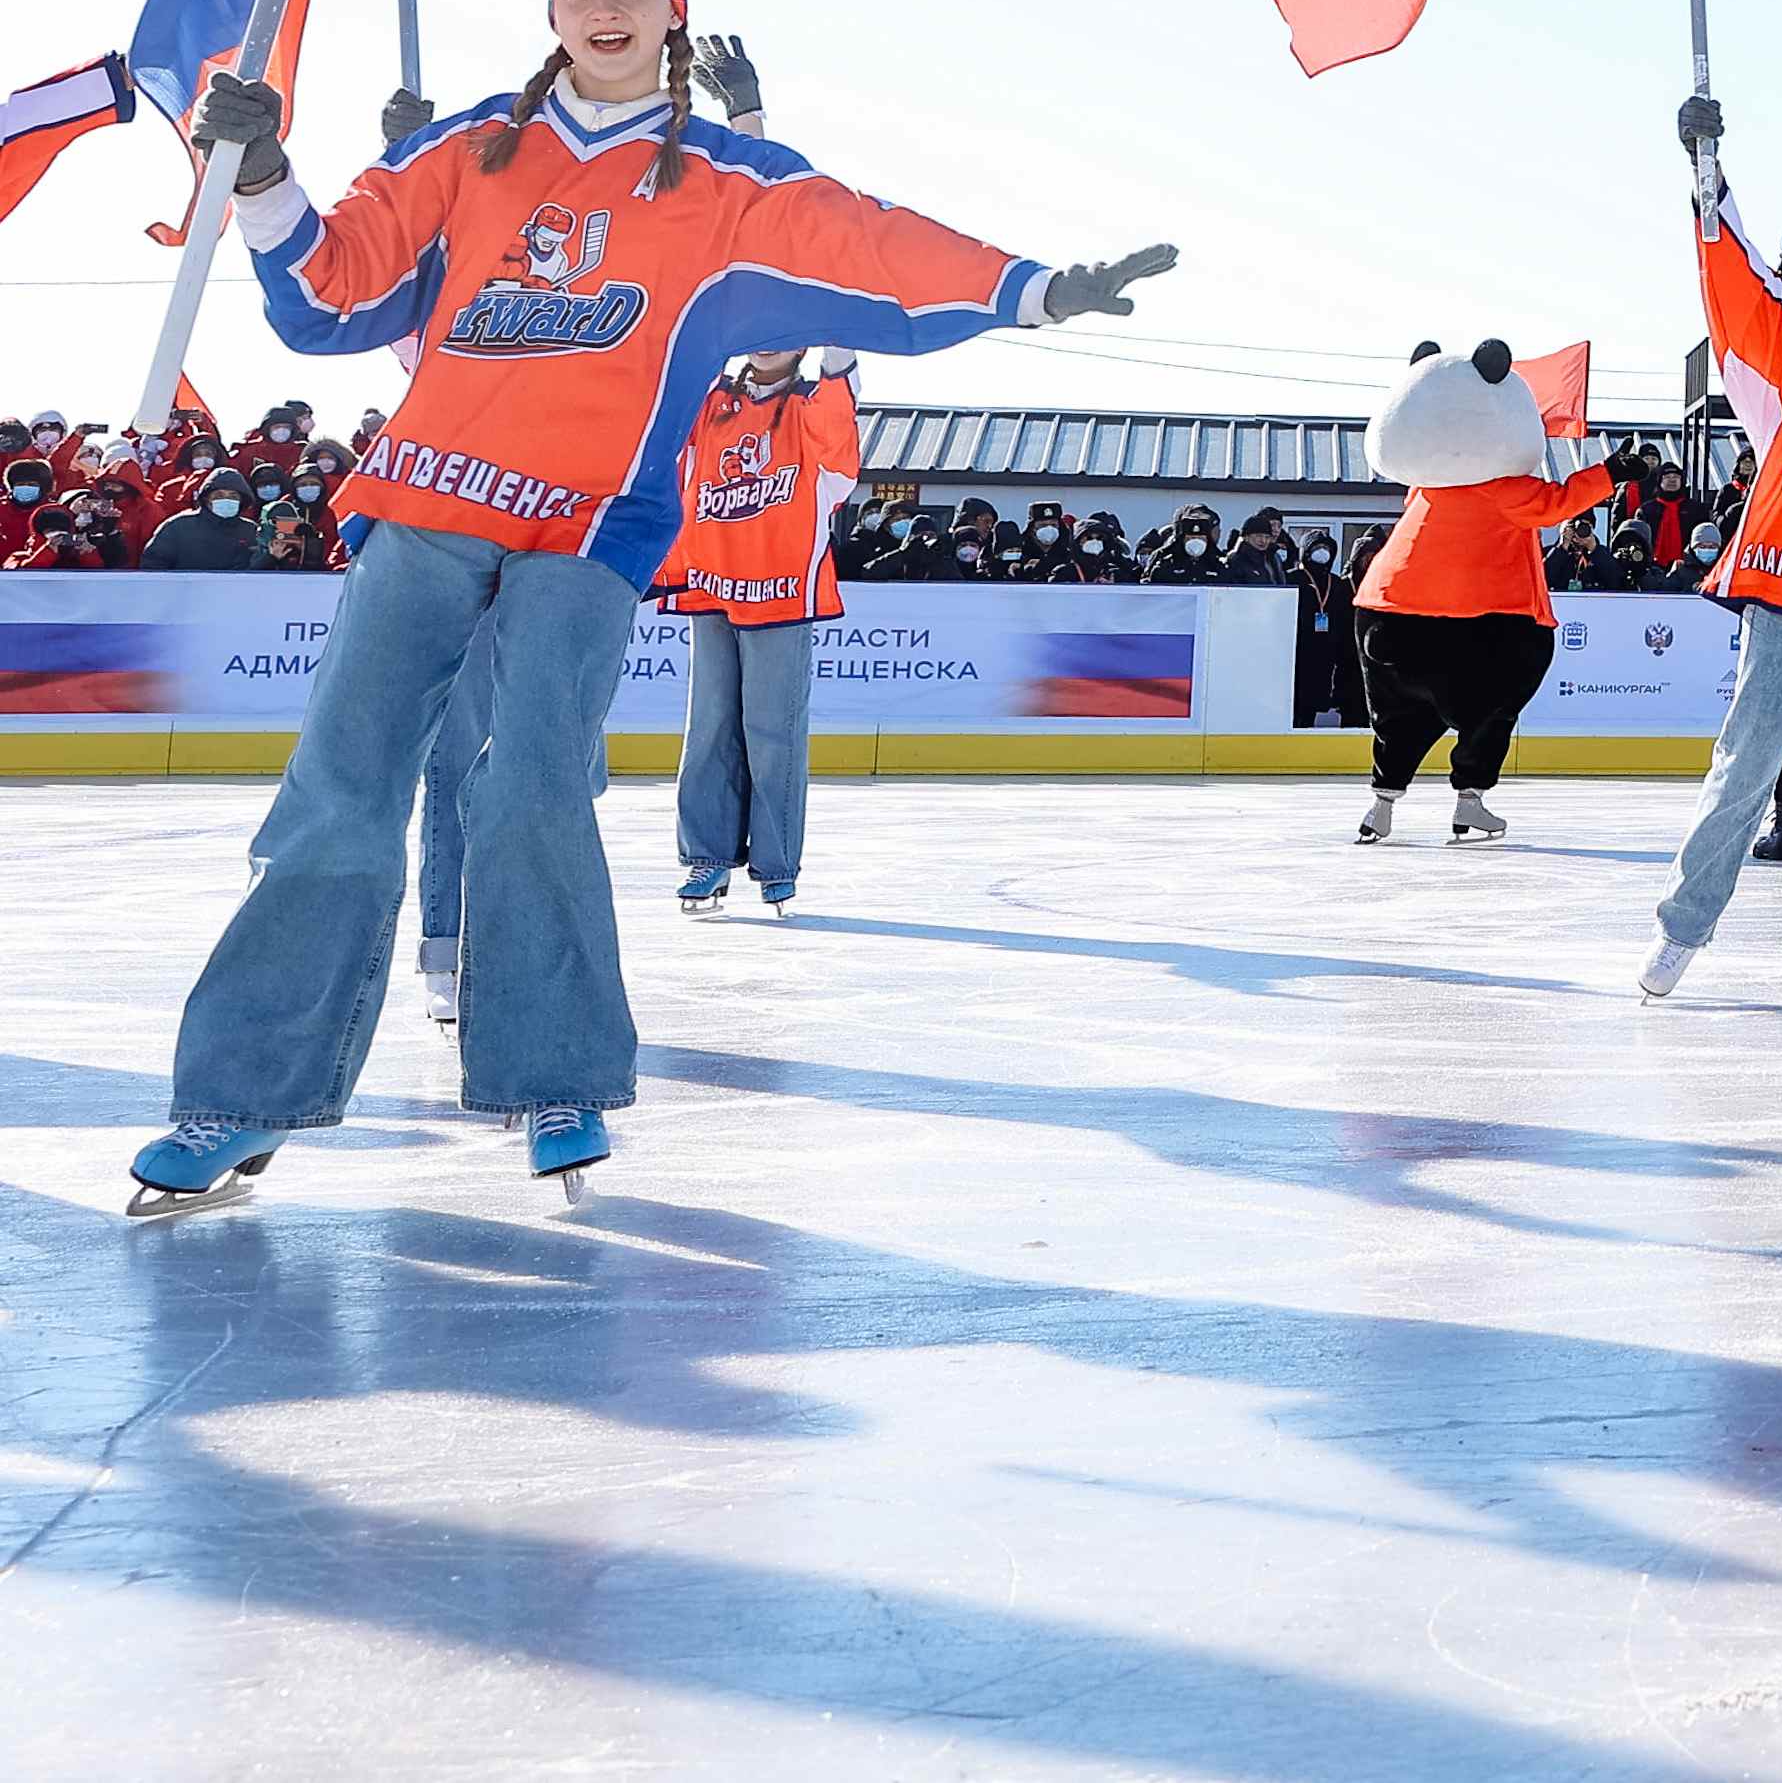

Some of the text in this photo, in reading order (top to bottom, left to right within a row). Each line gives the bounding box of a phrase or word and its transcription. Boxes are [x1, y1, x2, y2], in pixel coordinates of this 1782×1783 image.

[812, 628, 930, 648] ЛАСТИ
[814, 660, 979, 682] ЕЩЕНСКА
[1577, 684, 1662, 694] КАНИКУРГАН
